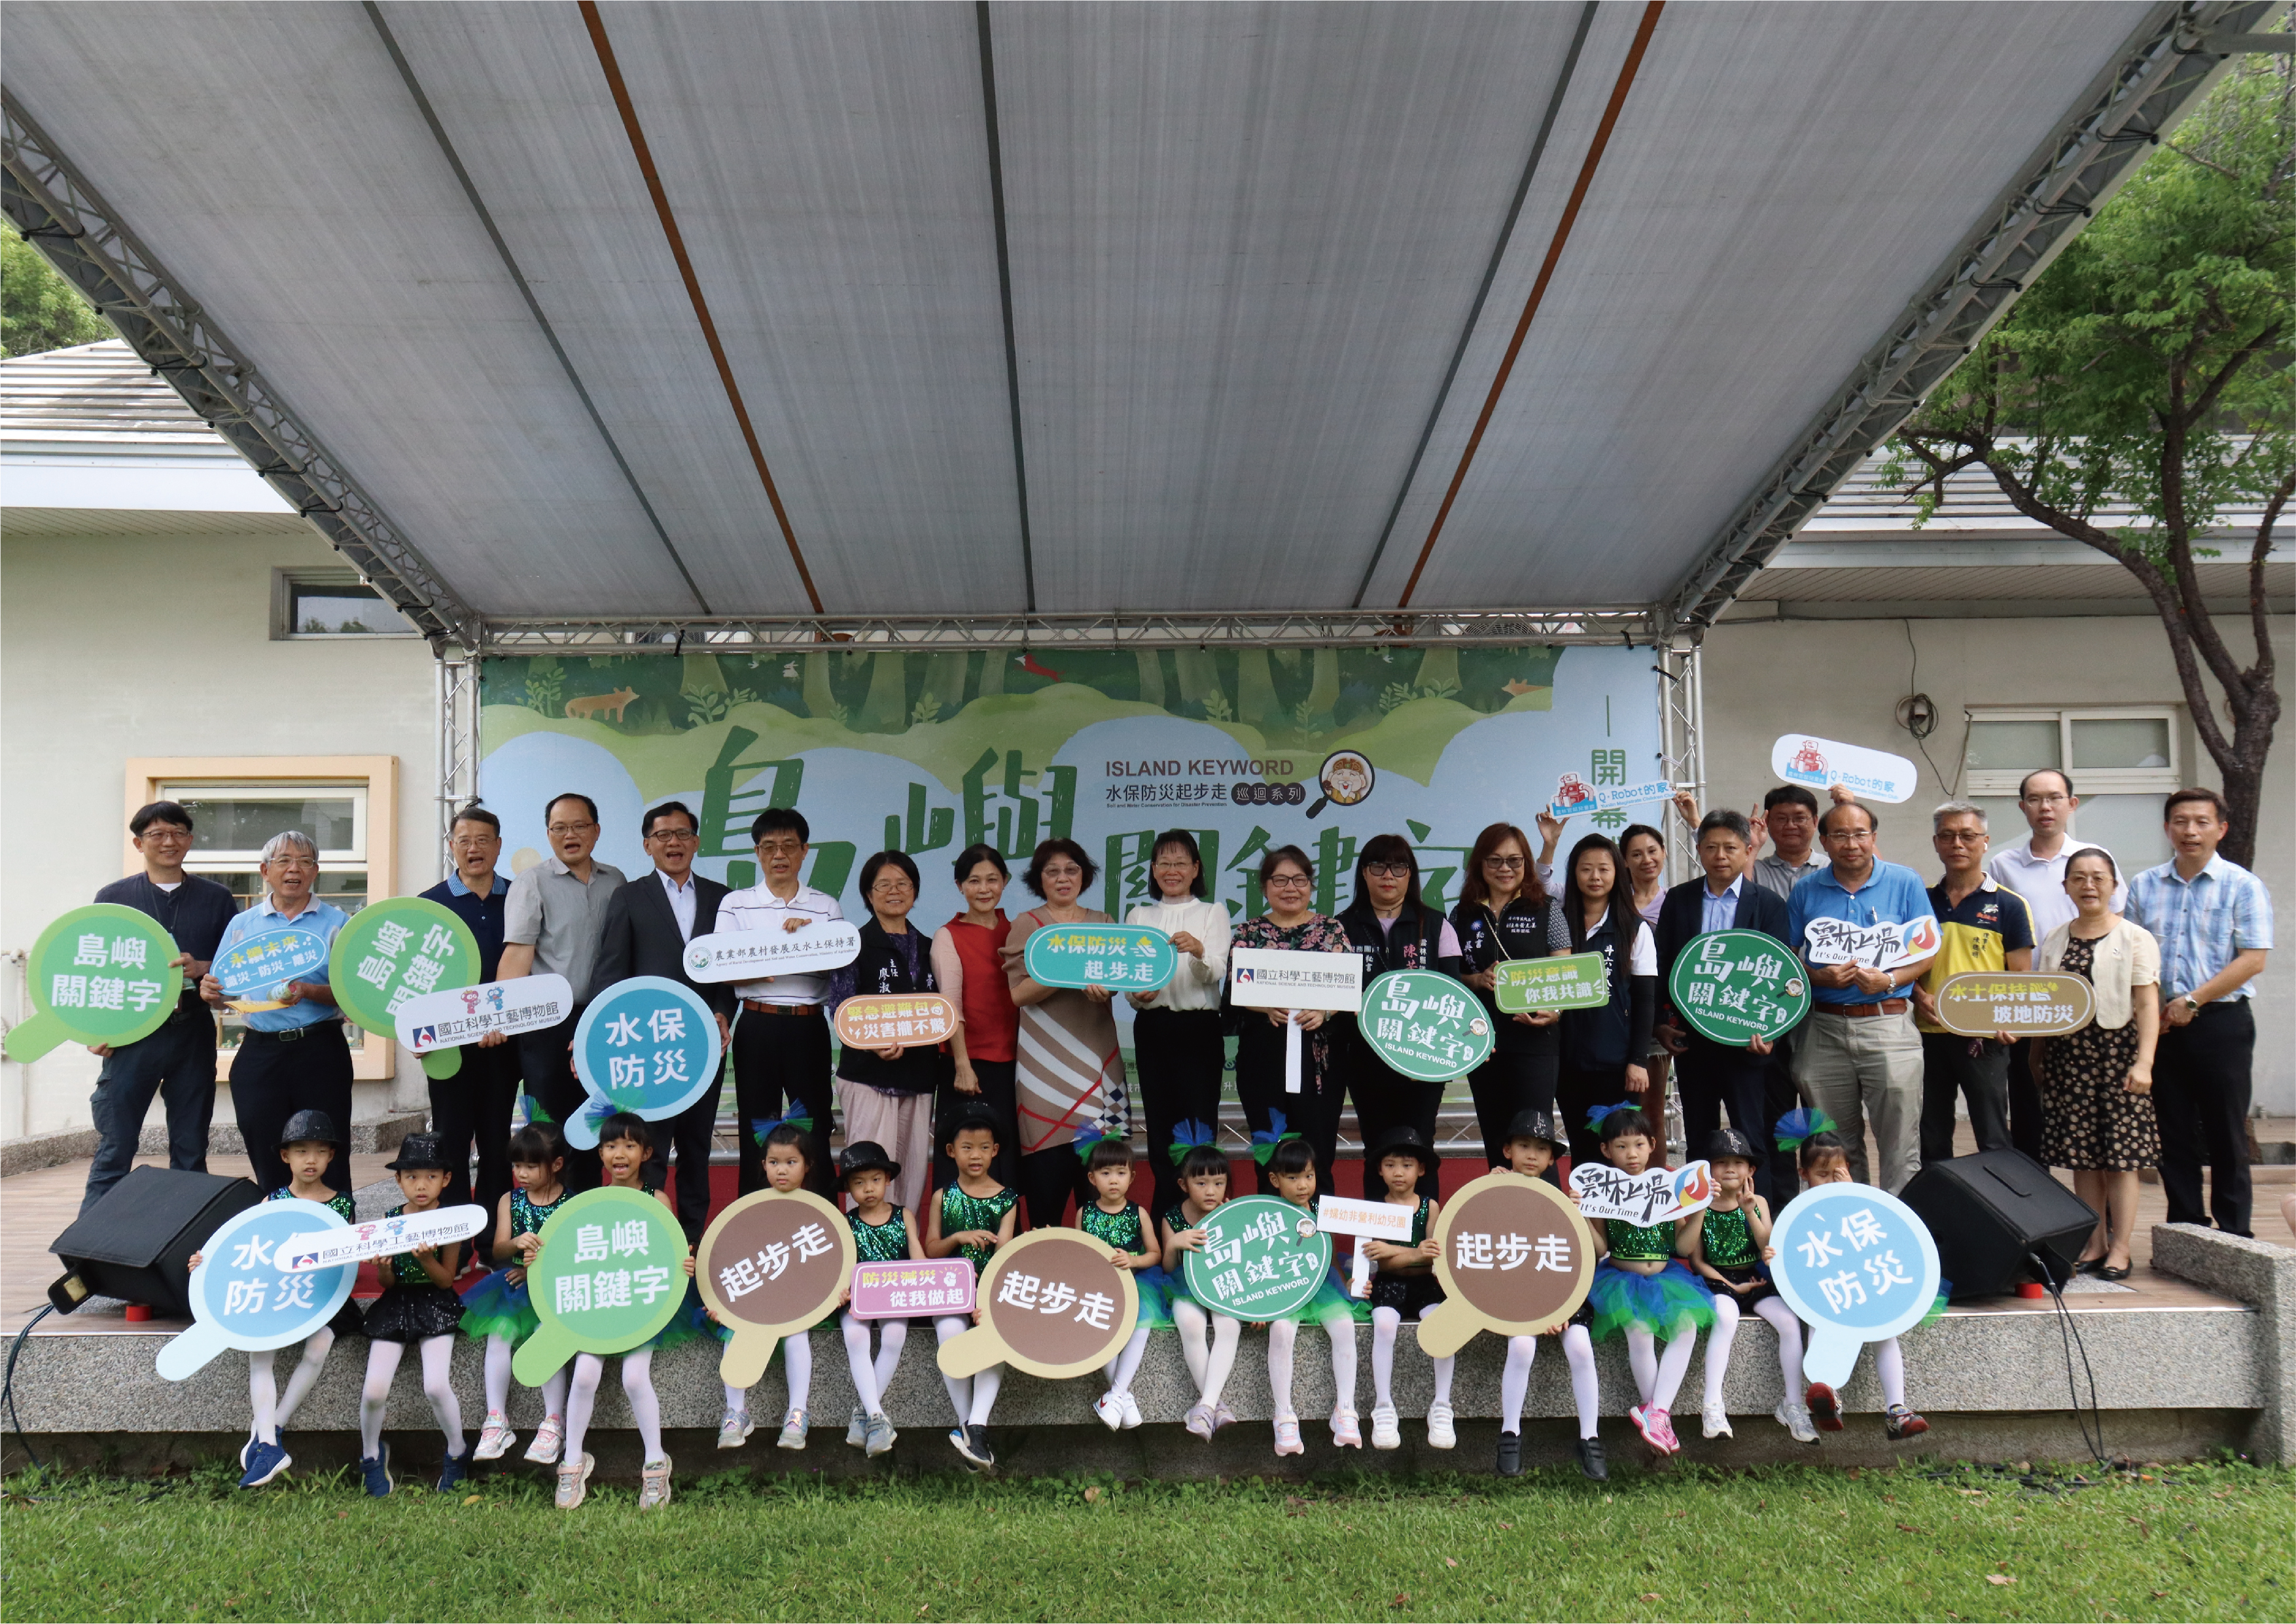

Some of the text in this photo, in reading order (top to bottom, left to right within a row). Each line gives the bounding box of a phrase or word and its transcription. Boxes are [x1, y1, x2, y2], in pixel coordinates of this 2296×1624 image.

[1106, 760, 1294, 777] ISLAND KEYWORD
[1105, 783, 1302, 802] 水保防災起步走 巡迴系列
[74, 933, 147, 970] 島嶼
[230, 936, 300, 969] 永續未來
[357, 920, 414, 991] 島嶼
[715, 936, 857, 961] 農業部農村發展及水土保持署
[1047, 934, 1127, 957] 水保防災
[1693, 934, 1784, 991] 島嶼
[1811, 921, 1901, 968] 雲林上場
[890, 959, 898, 977] 主任
[1256, 969, 1356, 984] 國立科學工藝博物館
[1510, 964, 1578, 987] 防災意識
[52, 974, 162, 1012] 關鍵字
[1381, 974, 1465, 1029] 島嶼
[1525, 981, 1593, 1004] 你我共識
[1687, 982, 1779, 1023] 關鍵字
[1949, 981, 2028, 1002] 水土保持
[438, 1002, 559, 1037] 國立科學工藝博物館
[440, 1034, 467, 1044] NATIONAL
[503, 1020, 538, 1031] TECHNOLOGY
[539, 1015, 561, 1024] MUSEUM
[605, 1008, 686, 1047] 水保
[847, 1001, 930, 1022] 緊急避難包
[863, 1017, 946, 1040] 災害攏不驚
[1695, 1007, 1725, 1021] ISLAND
[1726, 1014, 1769, 1031] KEYWORD
[1993, 1004, 2074, 1025] 坡地防災
[1377, 1017, 1464, 1060] 關鍵字
[1385, 1042, 1415, 1057] ISLAND
[1416, 1051, 1457, 1068] KEYWORD
[609, 1049, 690, 1089] 防災
[1575, 1168, 1672, 1224] 雲林上場
[1580, 1203, 1639, 1218] It's Our Time
[323, 1222, 470, 1260] 國立科學工藝博物館
[323, 1255, 354, 1264] NATIONAL
[355, 1248, 383, 1257] SCIENCE
[442, 1231, 471, 1241] MUSEUM
[574, 1219, 650, 1263] 島嶼
[1202, 1211, 1290, 1270] 島嶼
[1456, 1231, 1574, 1273] 起步走
[1797, 1208, 1888, 1269] 水保
[719, 1222, 834, 1303] 起步走
[862, 1269, 936, 1290] 防災減災
[1211, 1250, 1305, 1301] 關鍵字
[223, 1273, 315, 1316] 防災
[554, 1265, 670, 1315] 關鍵字
[889, 1288, 965, 1308] 從我做起
[1232, 1277, 1310, 1307] ISLAND KEYWORD
[1818, 1249, 1914, 1315] 防災
[997, 1270, 1116, 1331] 起步走
